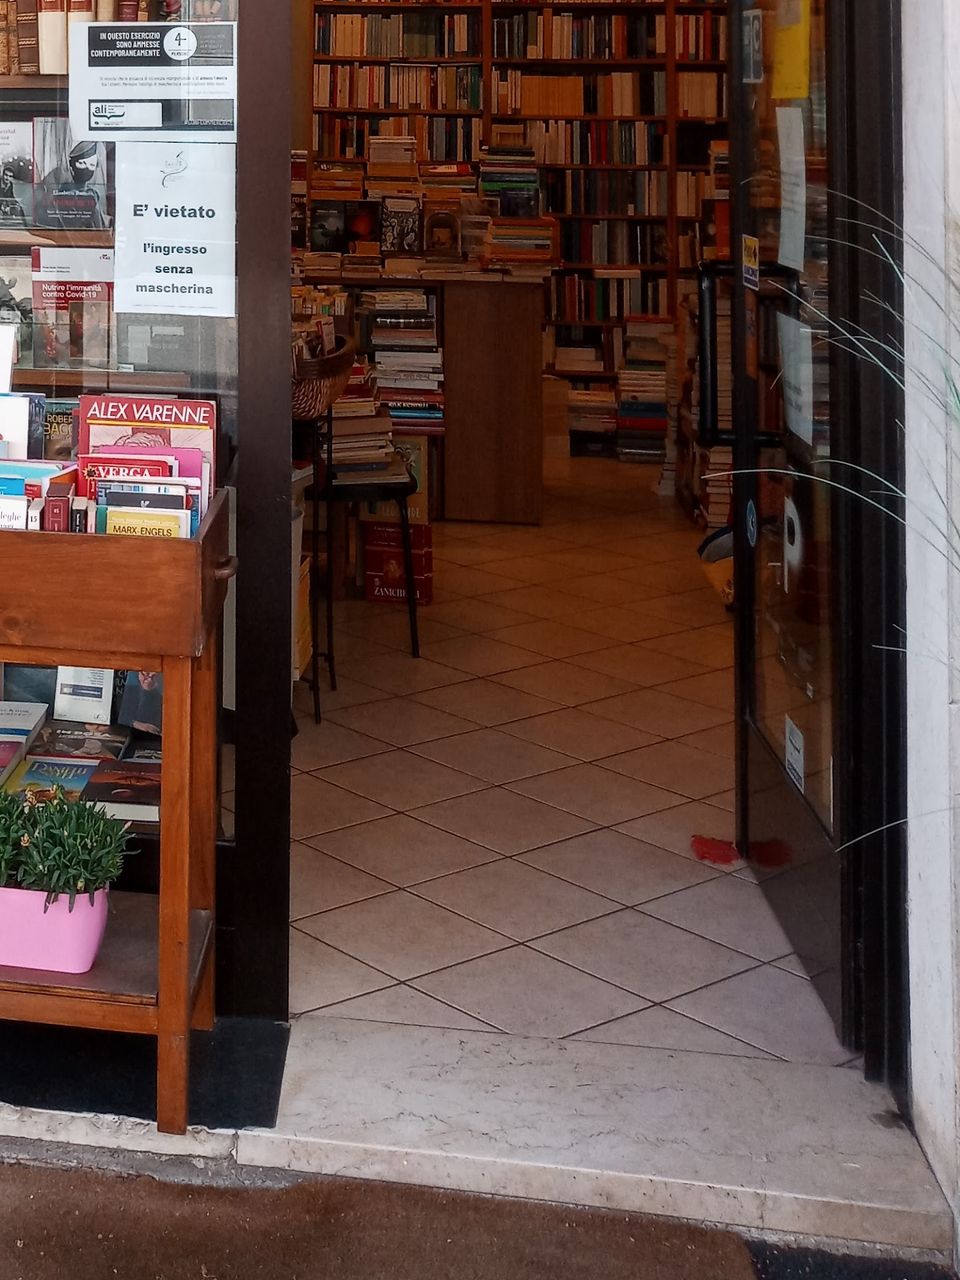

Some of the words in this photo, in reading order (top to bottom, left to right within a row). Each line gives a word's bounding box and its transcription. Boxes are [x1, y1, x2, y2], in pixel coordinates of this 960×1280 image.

[100, 32, 108, 40] IN
[108, 32, 130, 41] QUESTO
[131, 32, 161, 40] ESERCIZIO
[116, 41, 133, 49] SONO
[133, 41, 161, 49] AMMESSE
[91, 49, 161, 58] CONTEMPORANEAMENTE
[94, 104, 107, 114] ali
[154, 205, 216, 219] vietato
[155, 264, 194, 275] senza
[42, 283, 65, 292] Nutrire
[135, 283, 214, 295] mascherina
[66, 291, 97, 299] Covid-19
[87, 401, 128, 420] ALEX
[132, 404, 210, 424] VARENNE
[97, 466, 151, 478] VERGA
